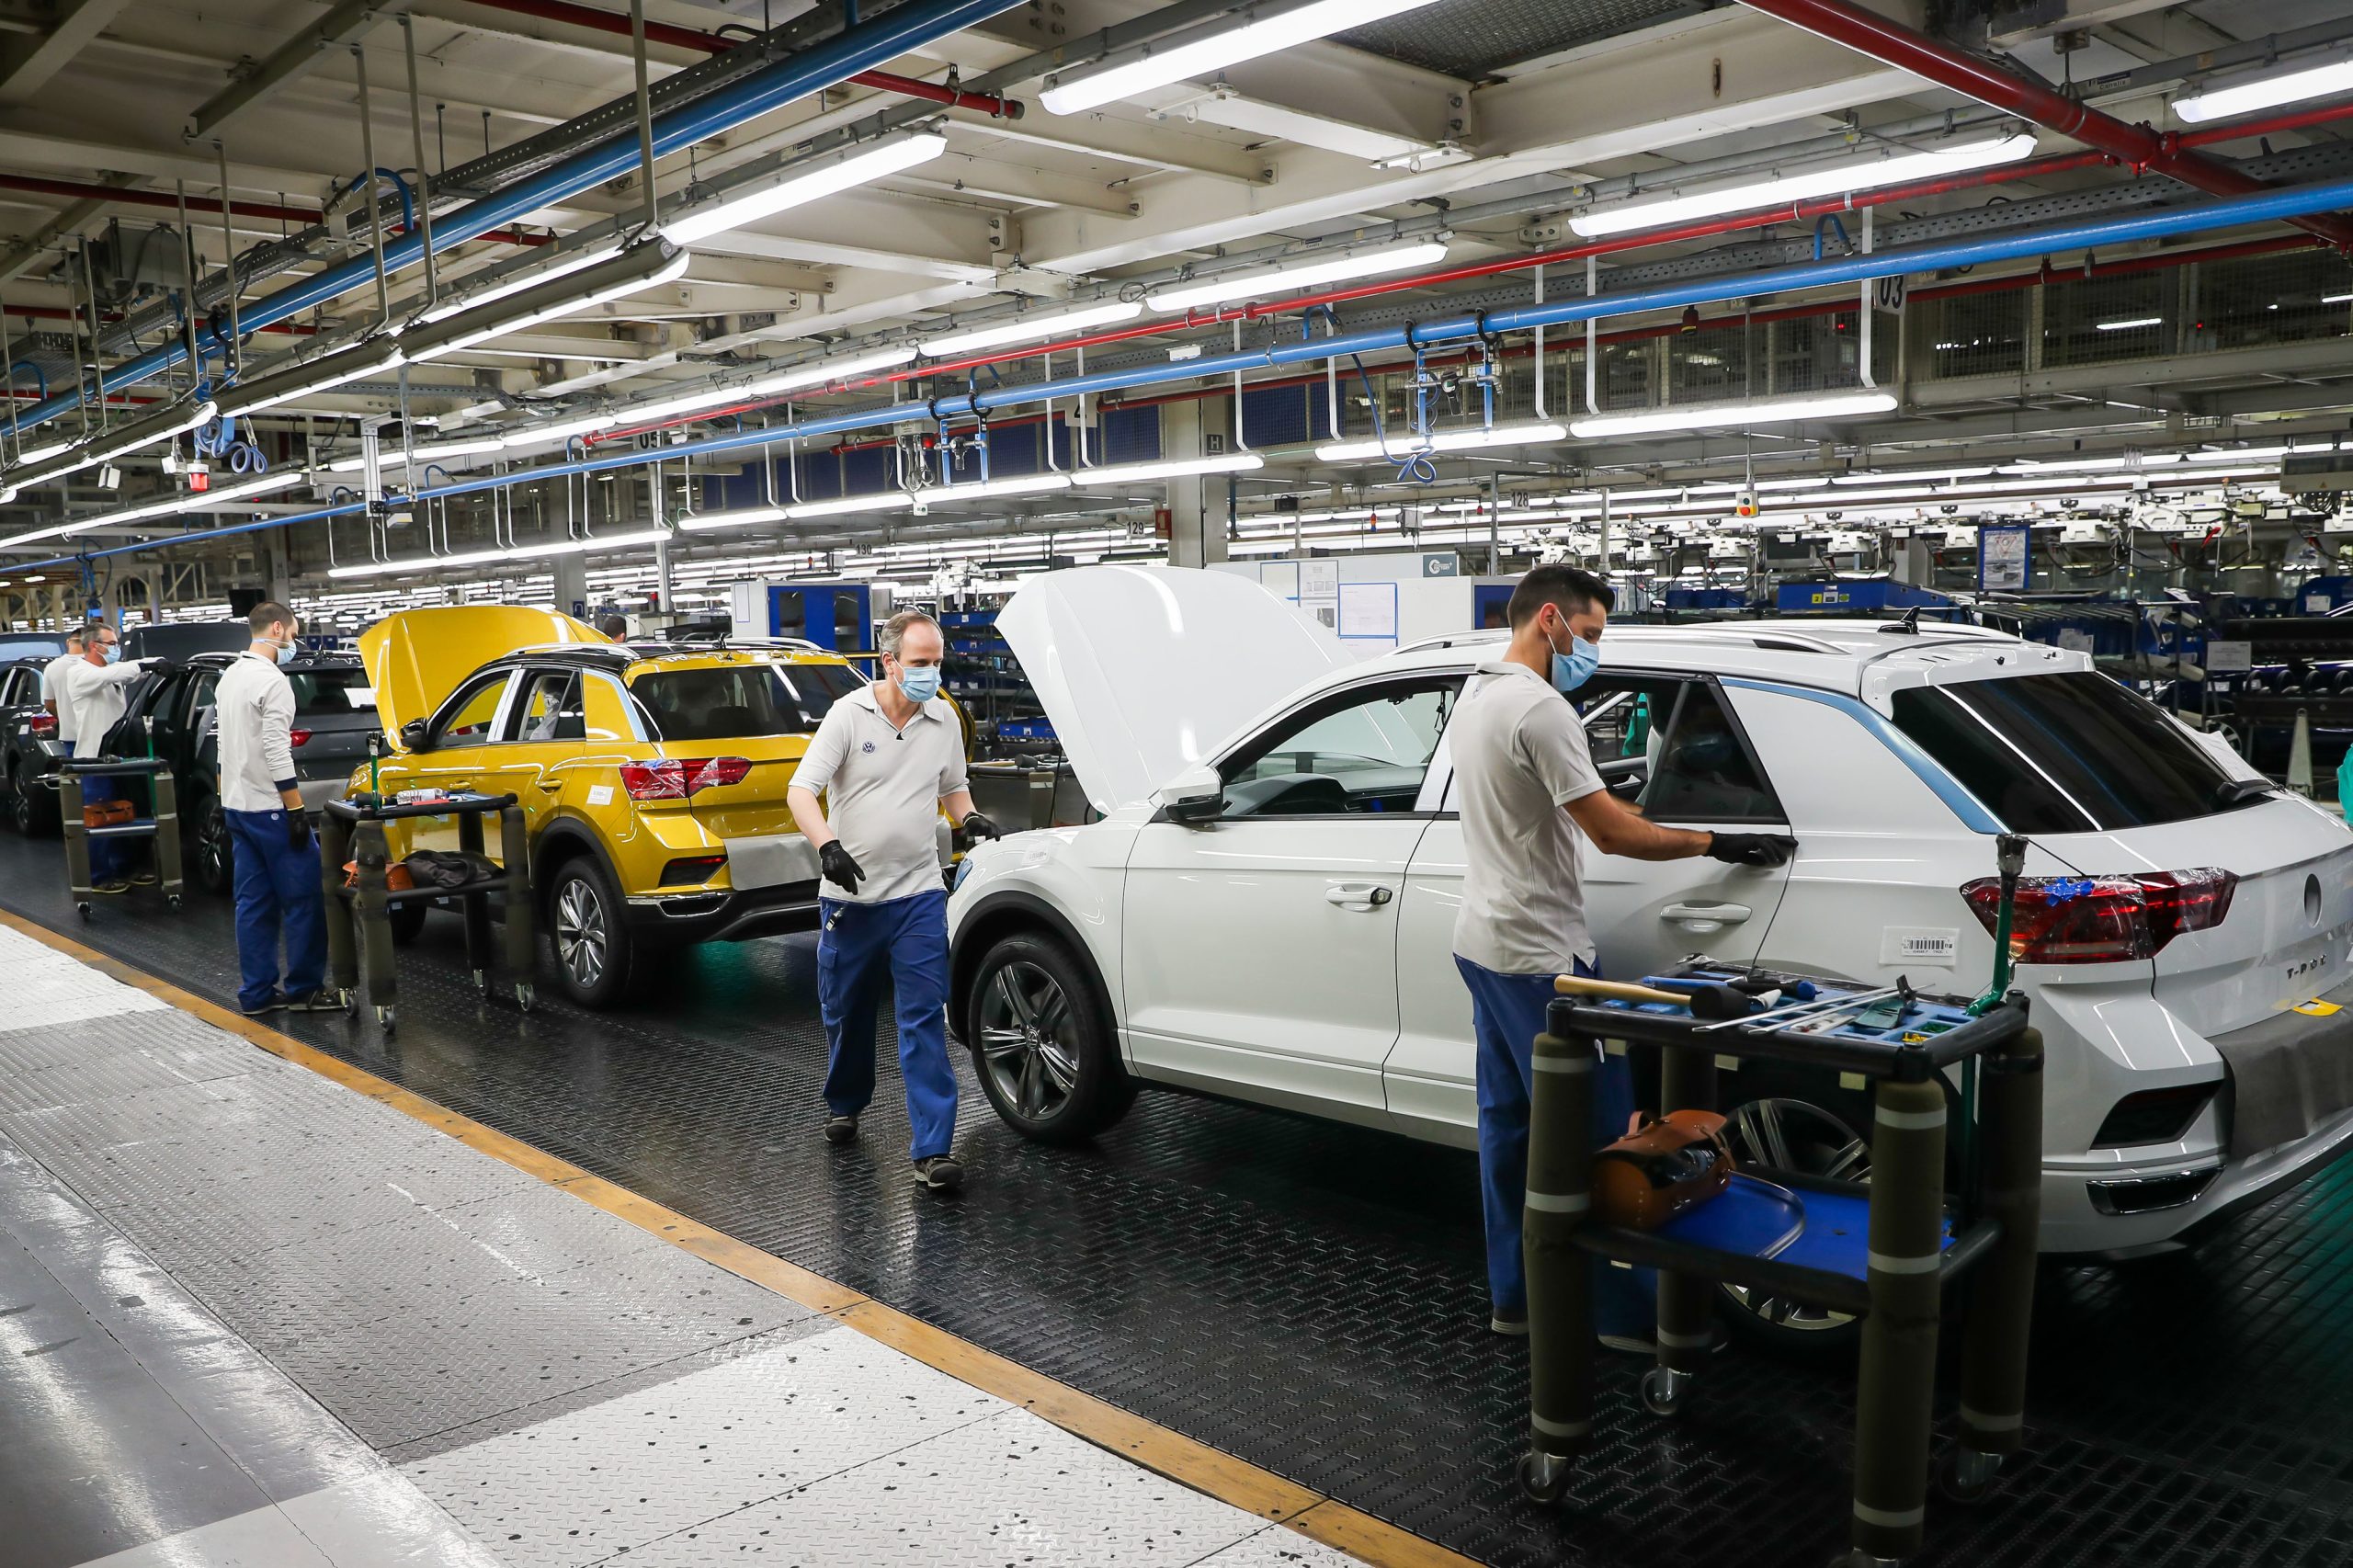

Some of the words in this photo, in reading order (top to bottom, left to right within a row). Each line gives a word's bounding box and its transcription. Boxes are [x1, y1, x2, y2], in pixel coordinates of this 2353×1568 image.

[1880, 275, 1904, 310] 03
[1210, 436, 1220, 449] H
[1511, 491, 1529, 507] 128
[1127, 521, 1144, 535] 129
[856, 543, 872, 555] 130
